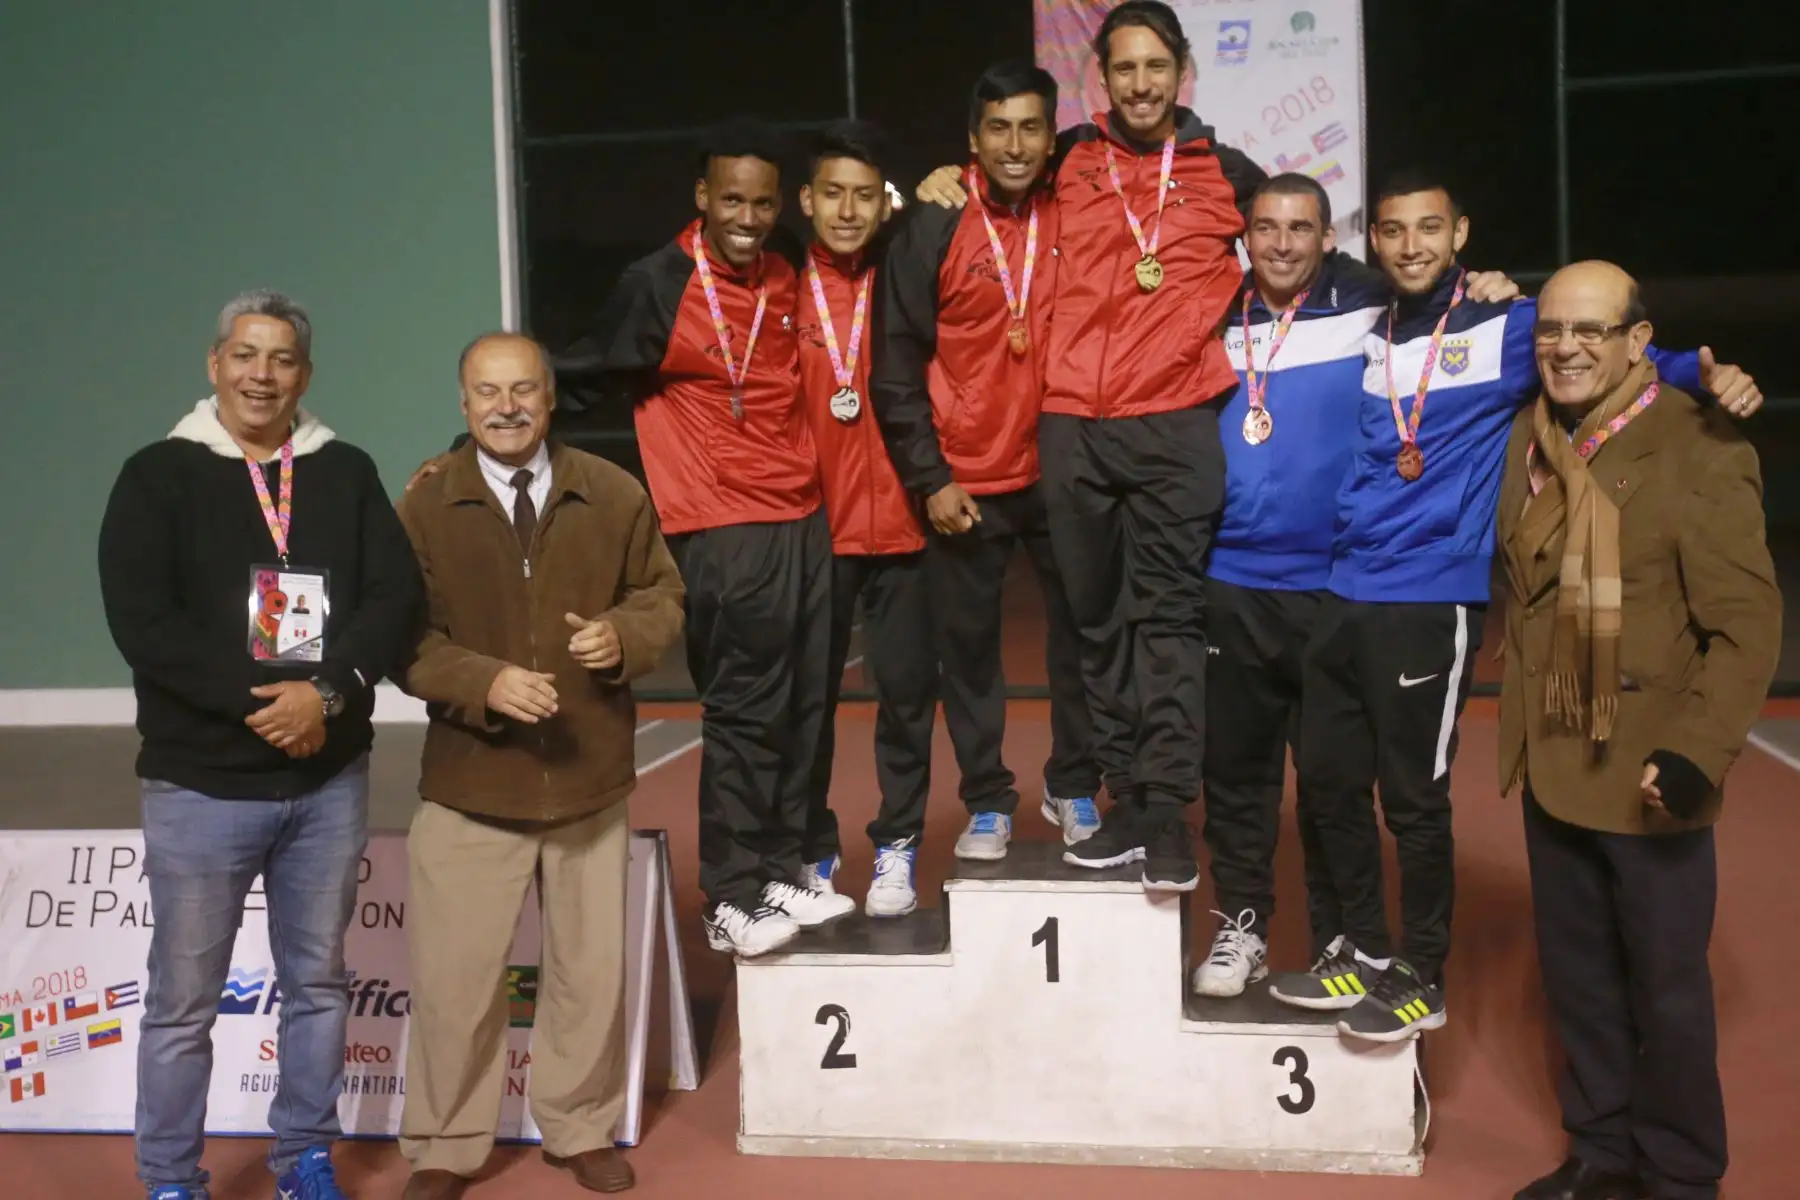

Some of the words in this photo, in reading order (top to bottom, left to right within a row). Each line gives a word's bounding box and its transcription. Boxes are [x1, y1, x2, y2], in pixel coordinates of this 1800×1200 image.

[1261, 75, 1336, 136] 2018
[67, 846, 96, 884] II
[1031, 916, 1060, 983] 1
[31, 965, 88, 1001] 2018
[814, 1003, 857, 1069] 2
[1272, 1045, 1316, 1114] 3
